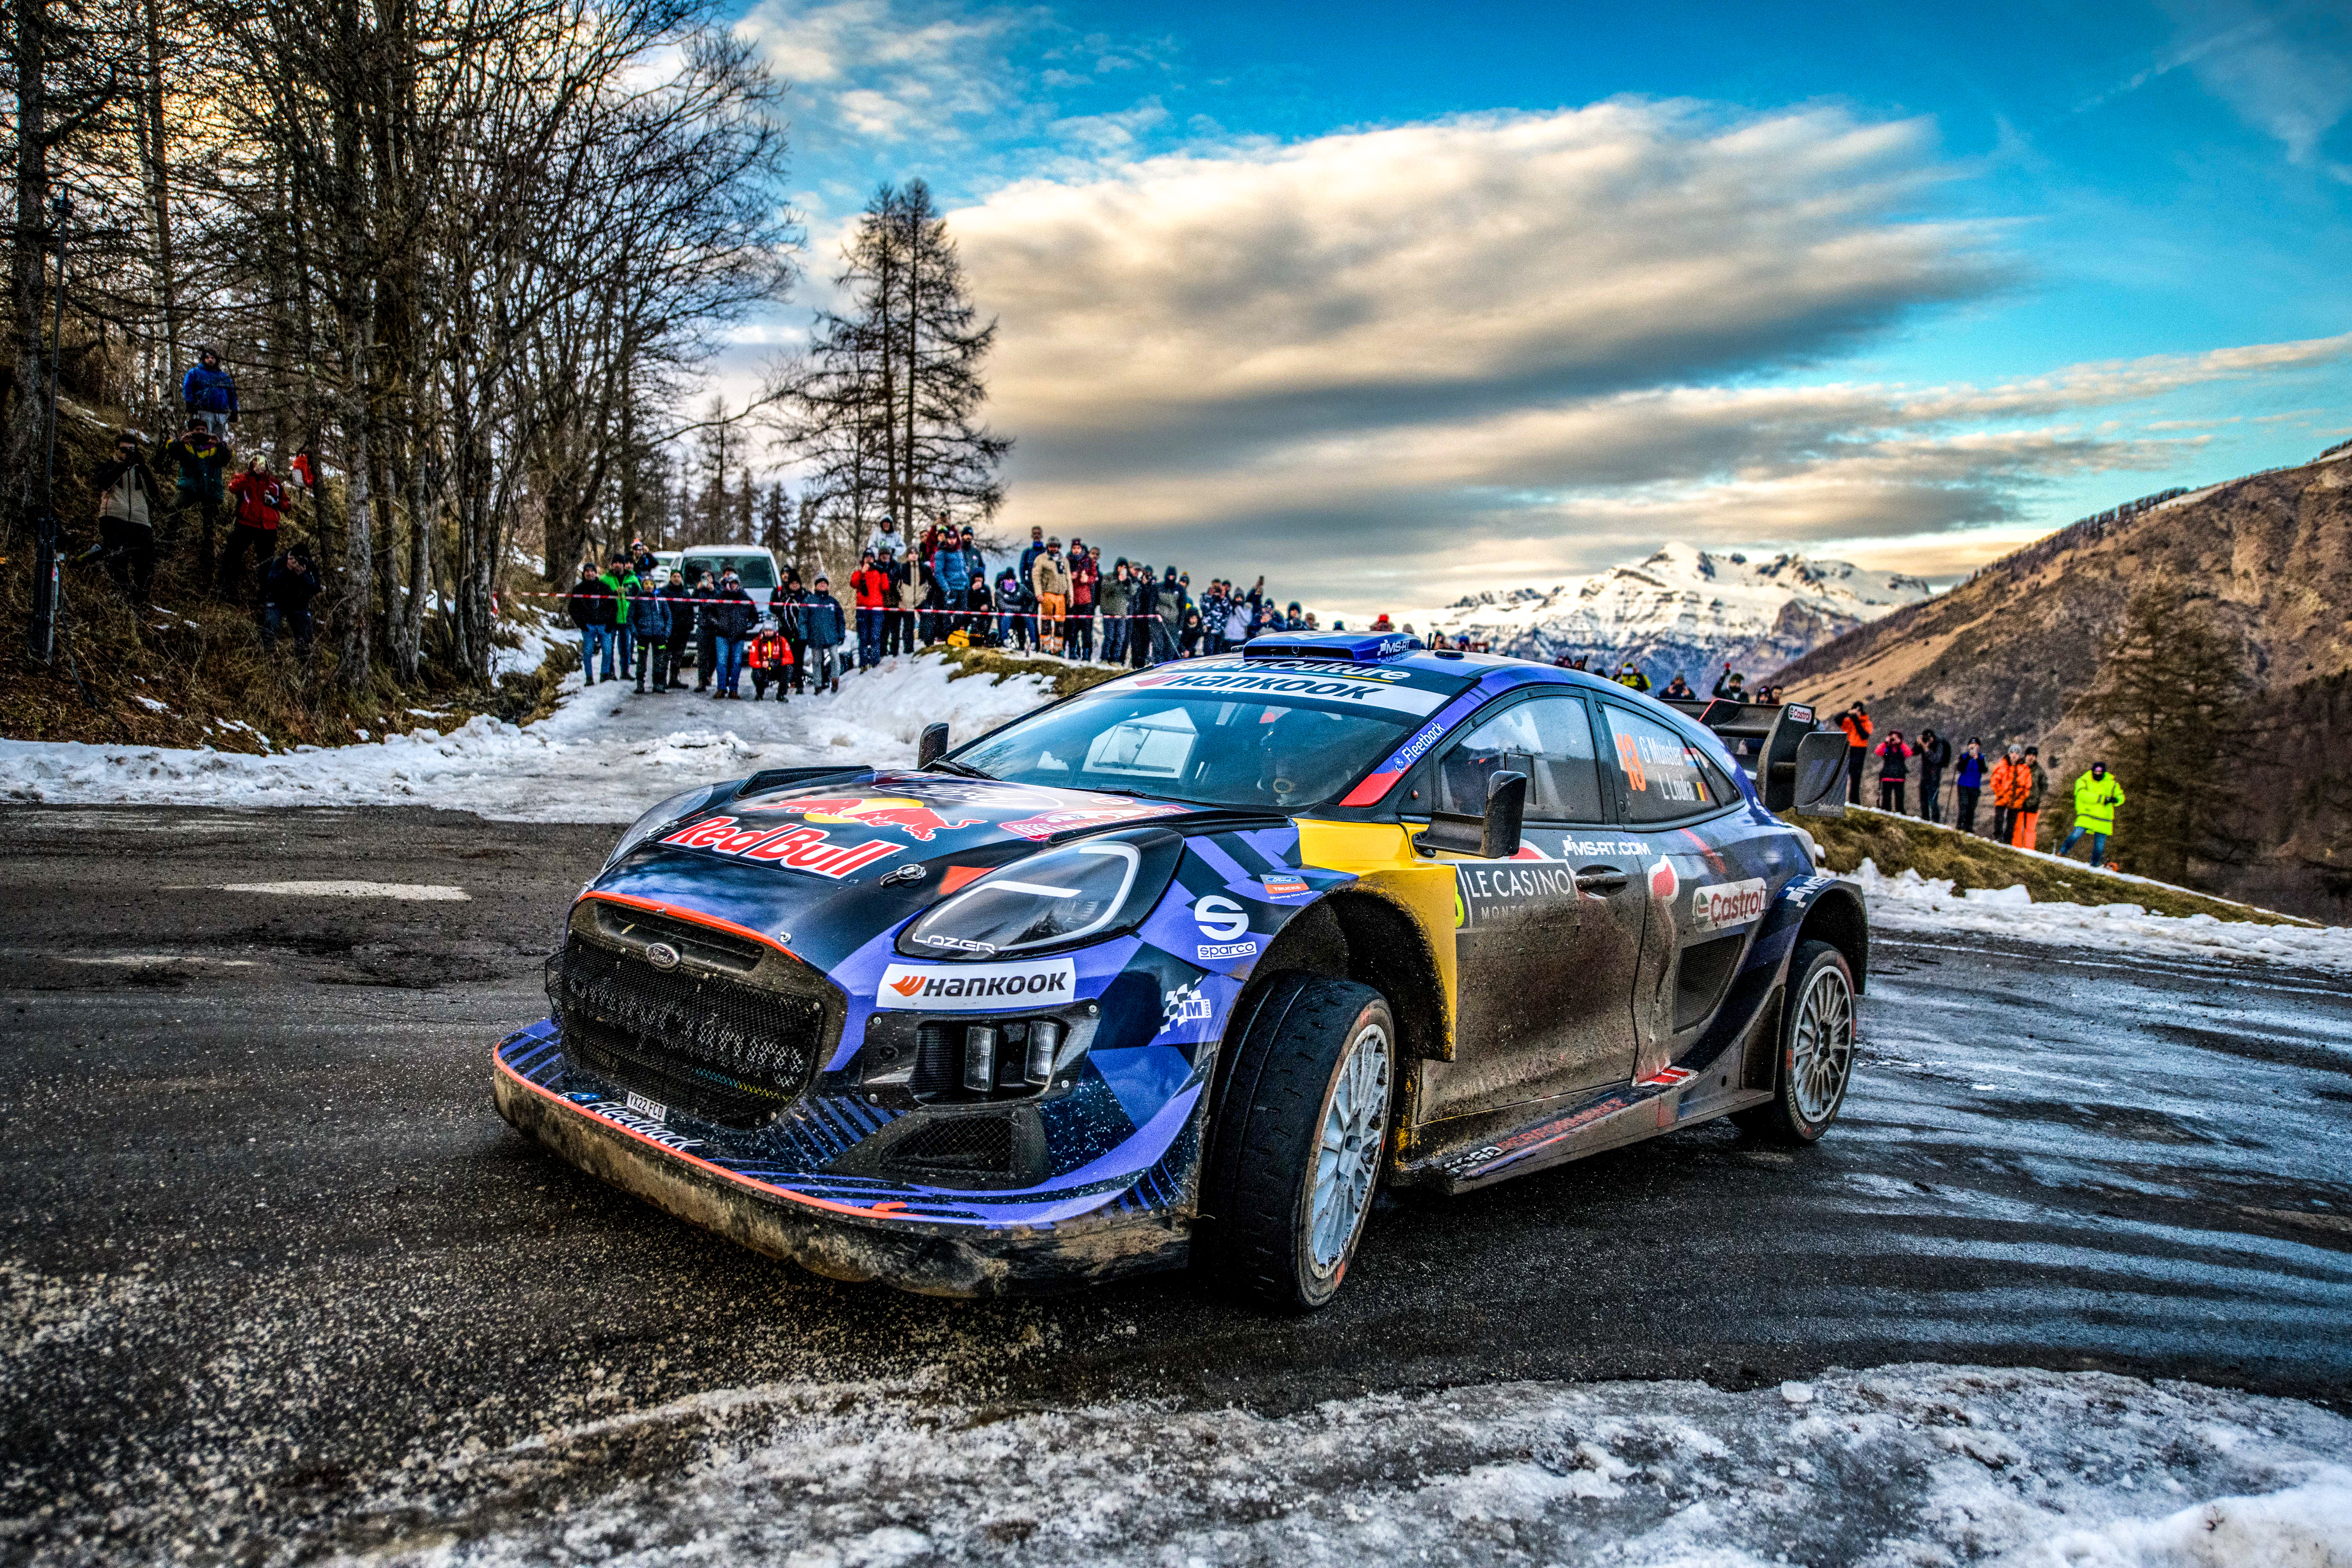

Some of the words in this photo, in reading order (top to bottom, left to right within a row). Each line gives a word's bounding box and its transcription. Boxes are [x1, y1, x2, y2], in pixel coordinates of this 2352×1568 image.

[1386, 640, 1410, 653] MS-RT
[1163, 660, 1411, 679] SafetyCulture
[1793, 709, 1810, 721] Castrol
[1402, 722, 1445, 763] Fleetback
[1616, 733, 1646, 791] 13
[1639, 736, 1651, 764] G
[1647, 737, 1684, 766] Munster
[1657, 772, 1669, 800] L
[1666, 773, 1695, 801] Louka
[659, 816, 802, 856] Red
[740, 826, 909, 879] Bull
[1465, 871, 1492, 897] LE
[1493, 869, 1571, 897] CASINO
[1710, 885, 1763, 923] Castrol
[912, 933, 995, 954] LAZER
[1200, 944, 1254, 958] sparco
[1185, 1002, 1202, 1017] M
[629, 1093, 647, 1111] YX22
[649, 1102, 663, 1118] FCD
[582, 1101, 705, 1152] Fleetback
